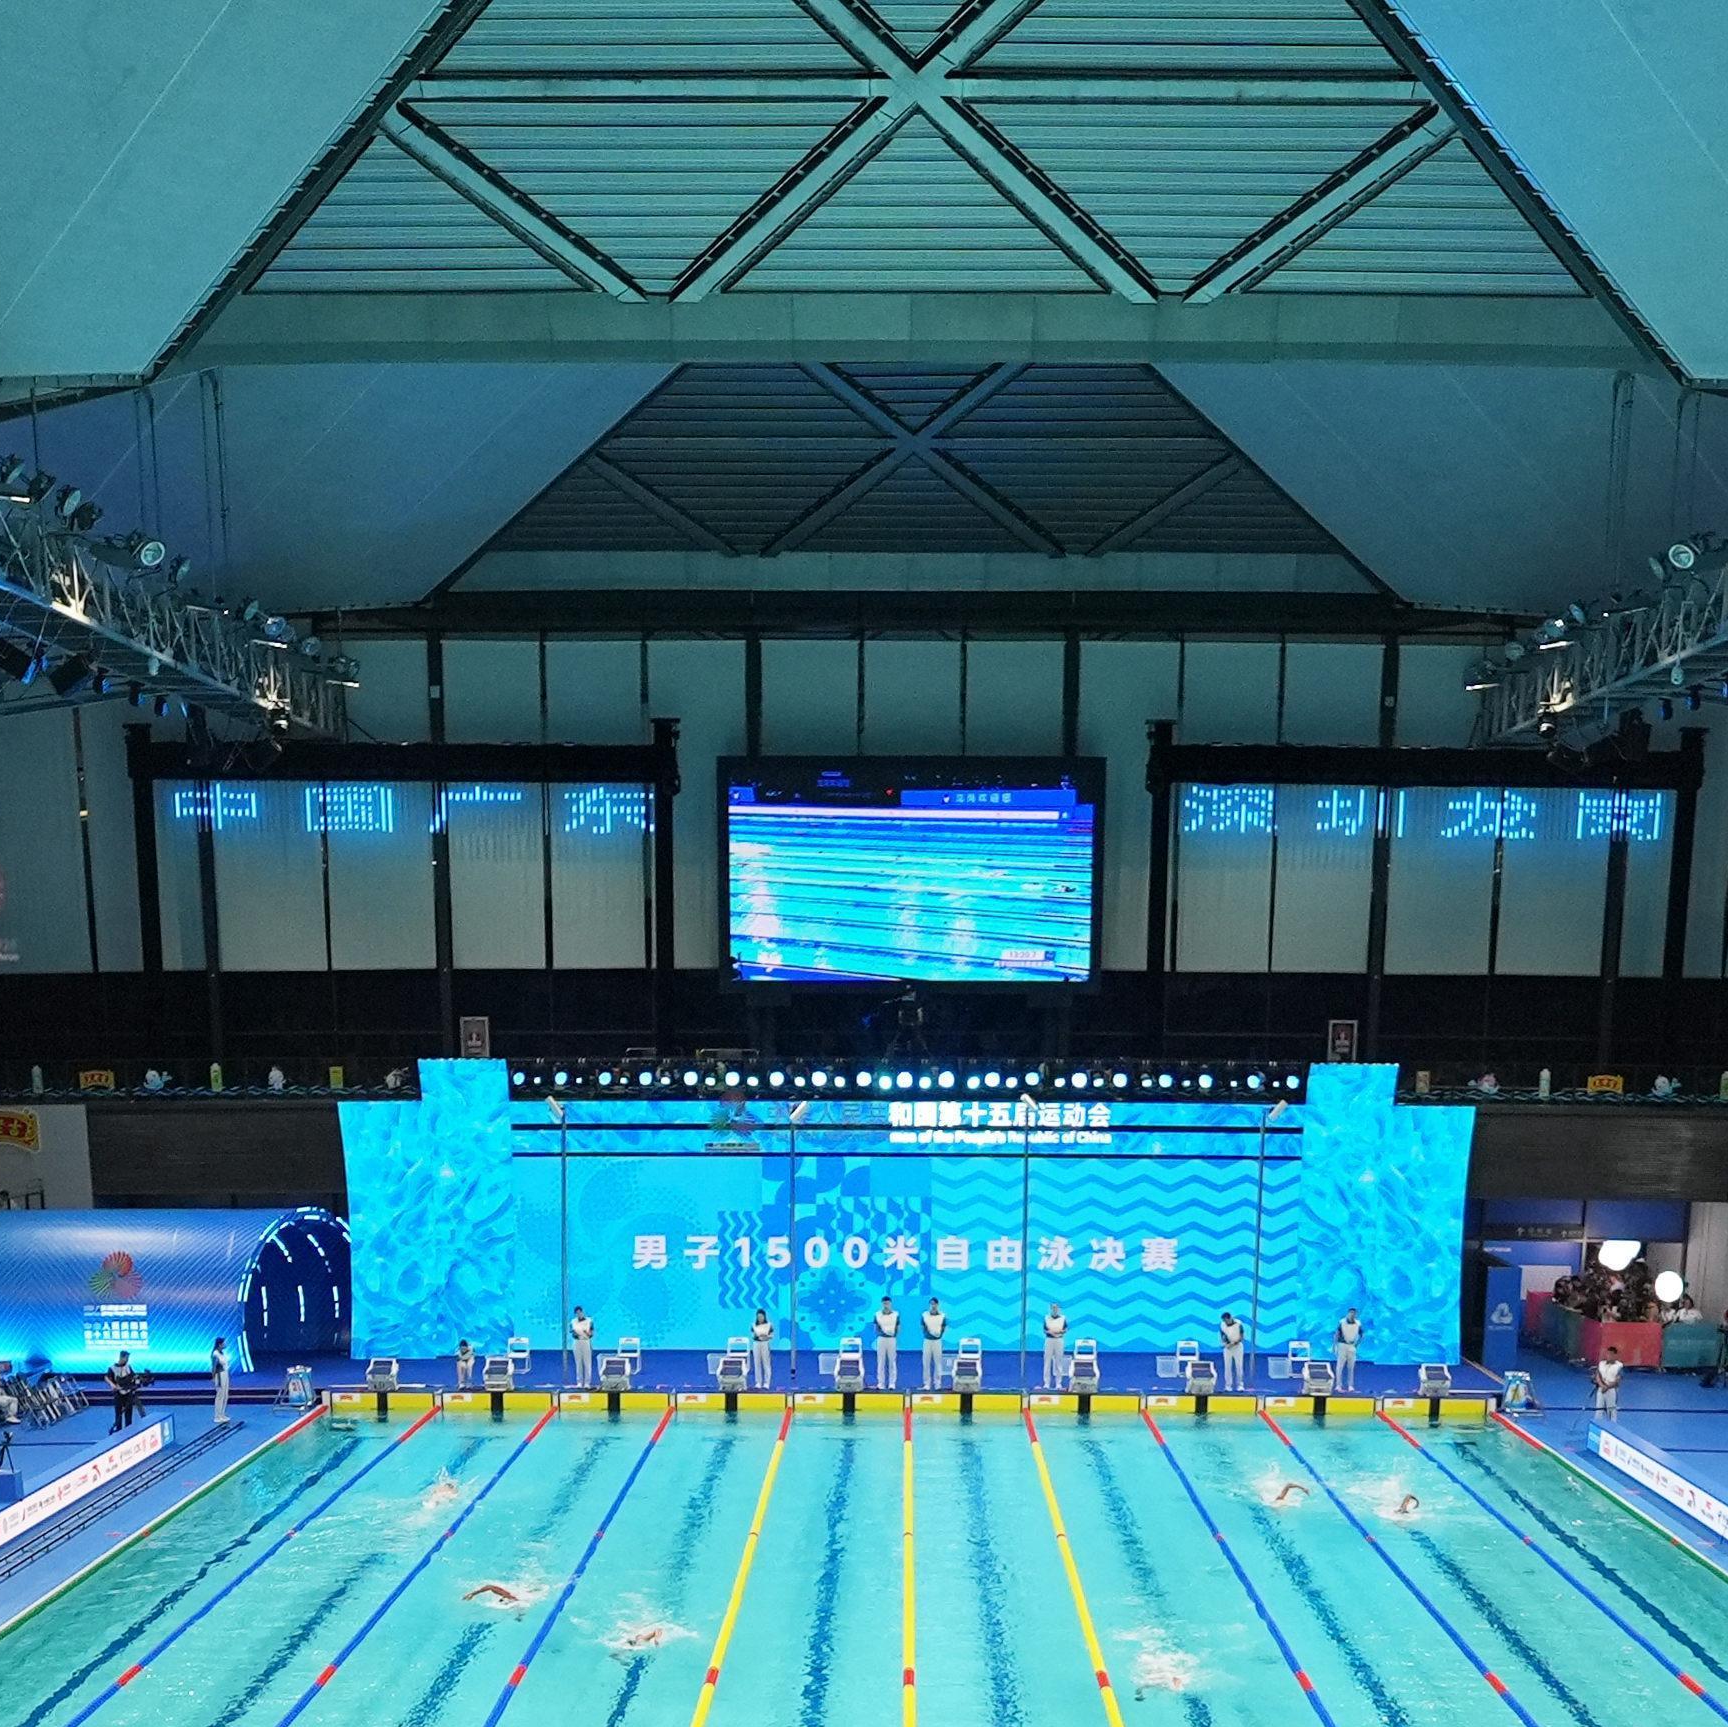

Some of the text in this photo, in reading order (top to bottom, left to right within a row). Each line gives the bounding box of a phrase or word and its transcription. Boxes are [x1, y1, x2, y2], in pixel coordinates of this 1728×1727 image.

[631, 1233, 1180, 1271] 男子1500米自由泳决赛
